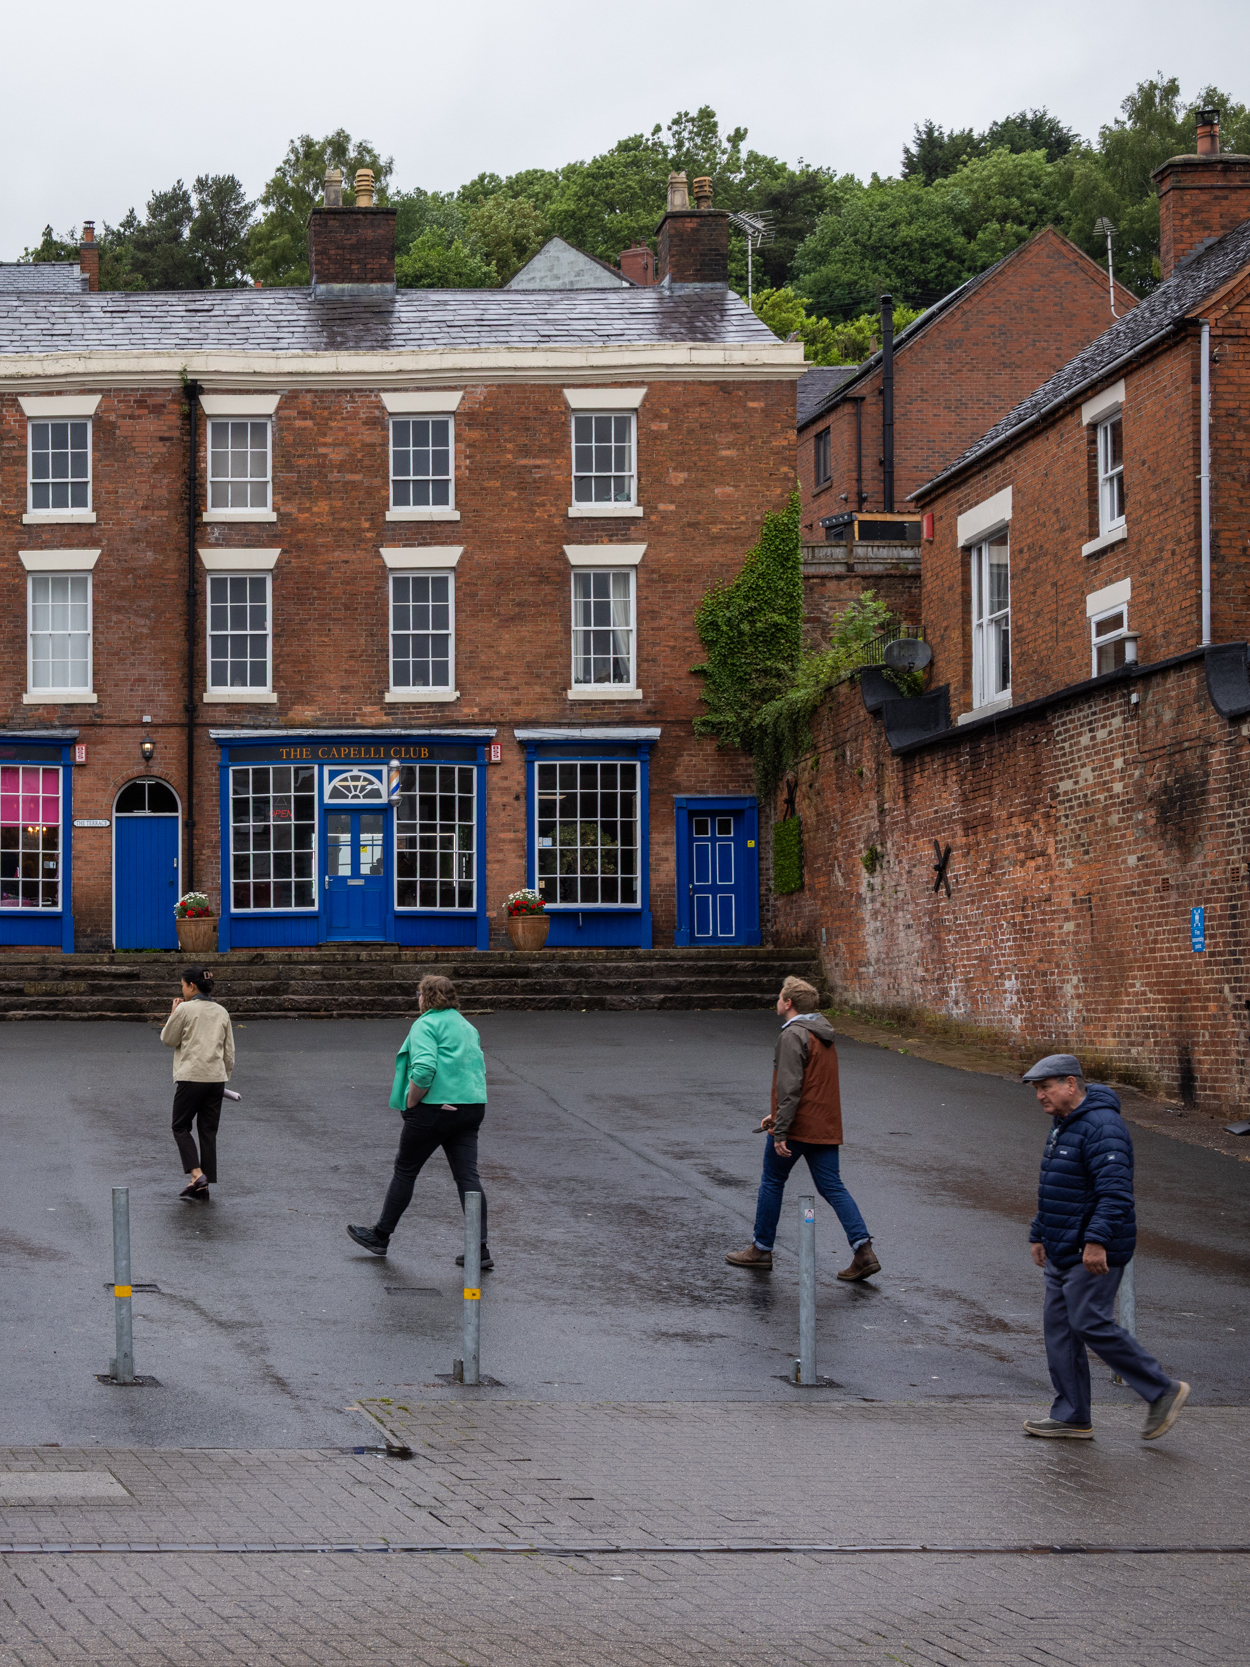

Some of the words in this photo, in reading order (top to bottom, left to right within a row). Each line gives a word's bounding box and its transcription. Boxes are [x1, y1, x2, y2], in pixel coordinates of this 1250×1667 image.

[280, 748, 312, 759] THE
[318, 747, 384, 758] CAPELLI
[390, 747, 429, 758] CLUB
[268, 809, 292, 818] OPEN
